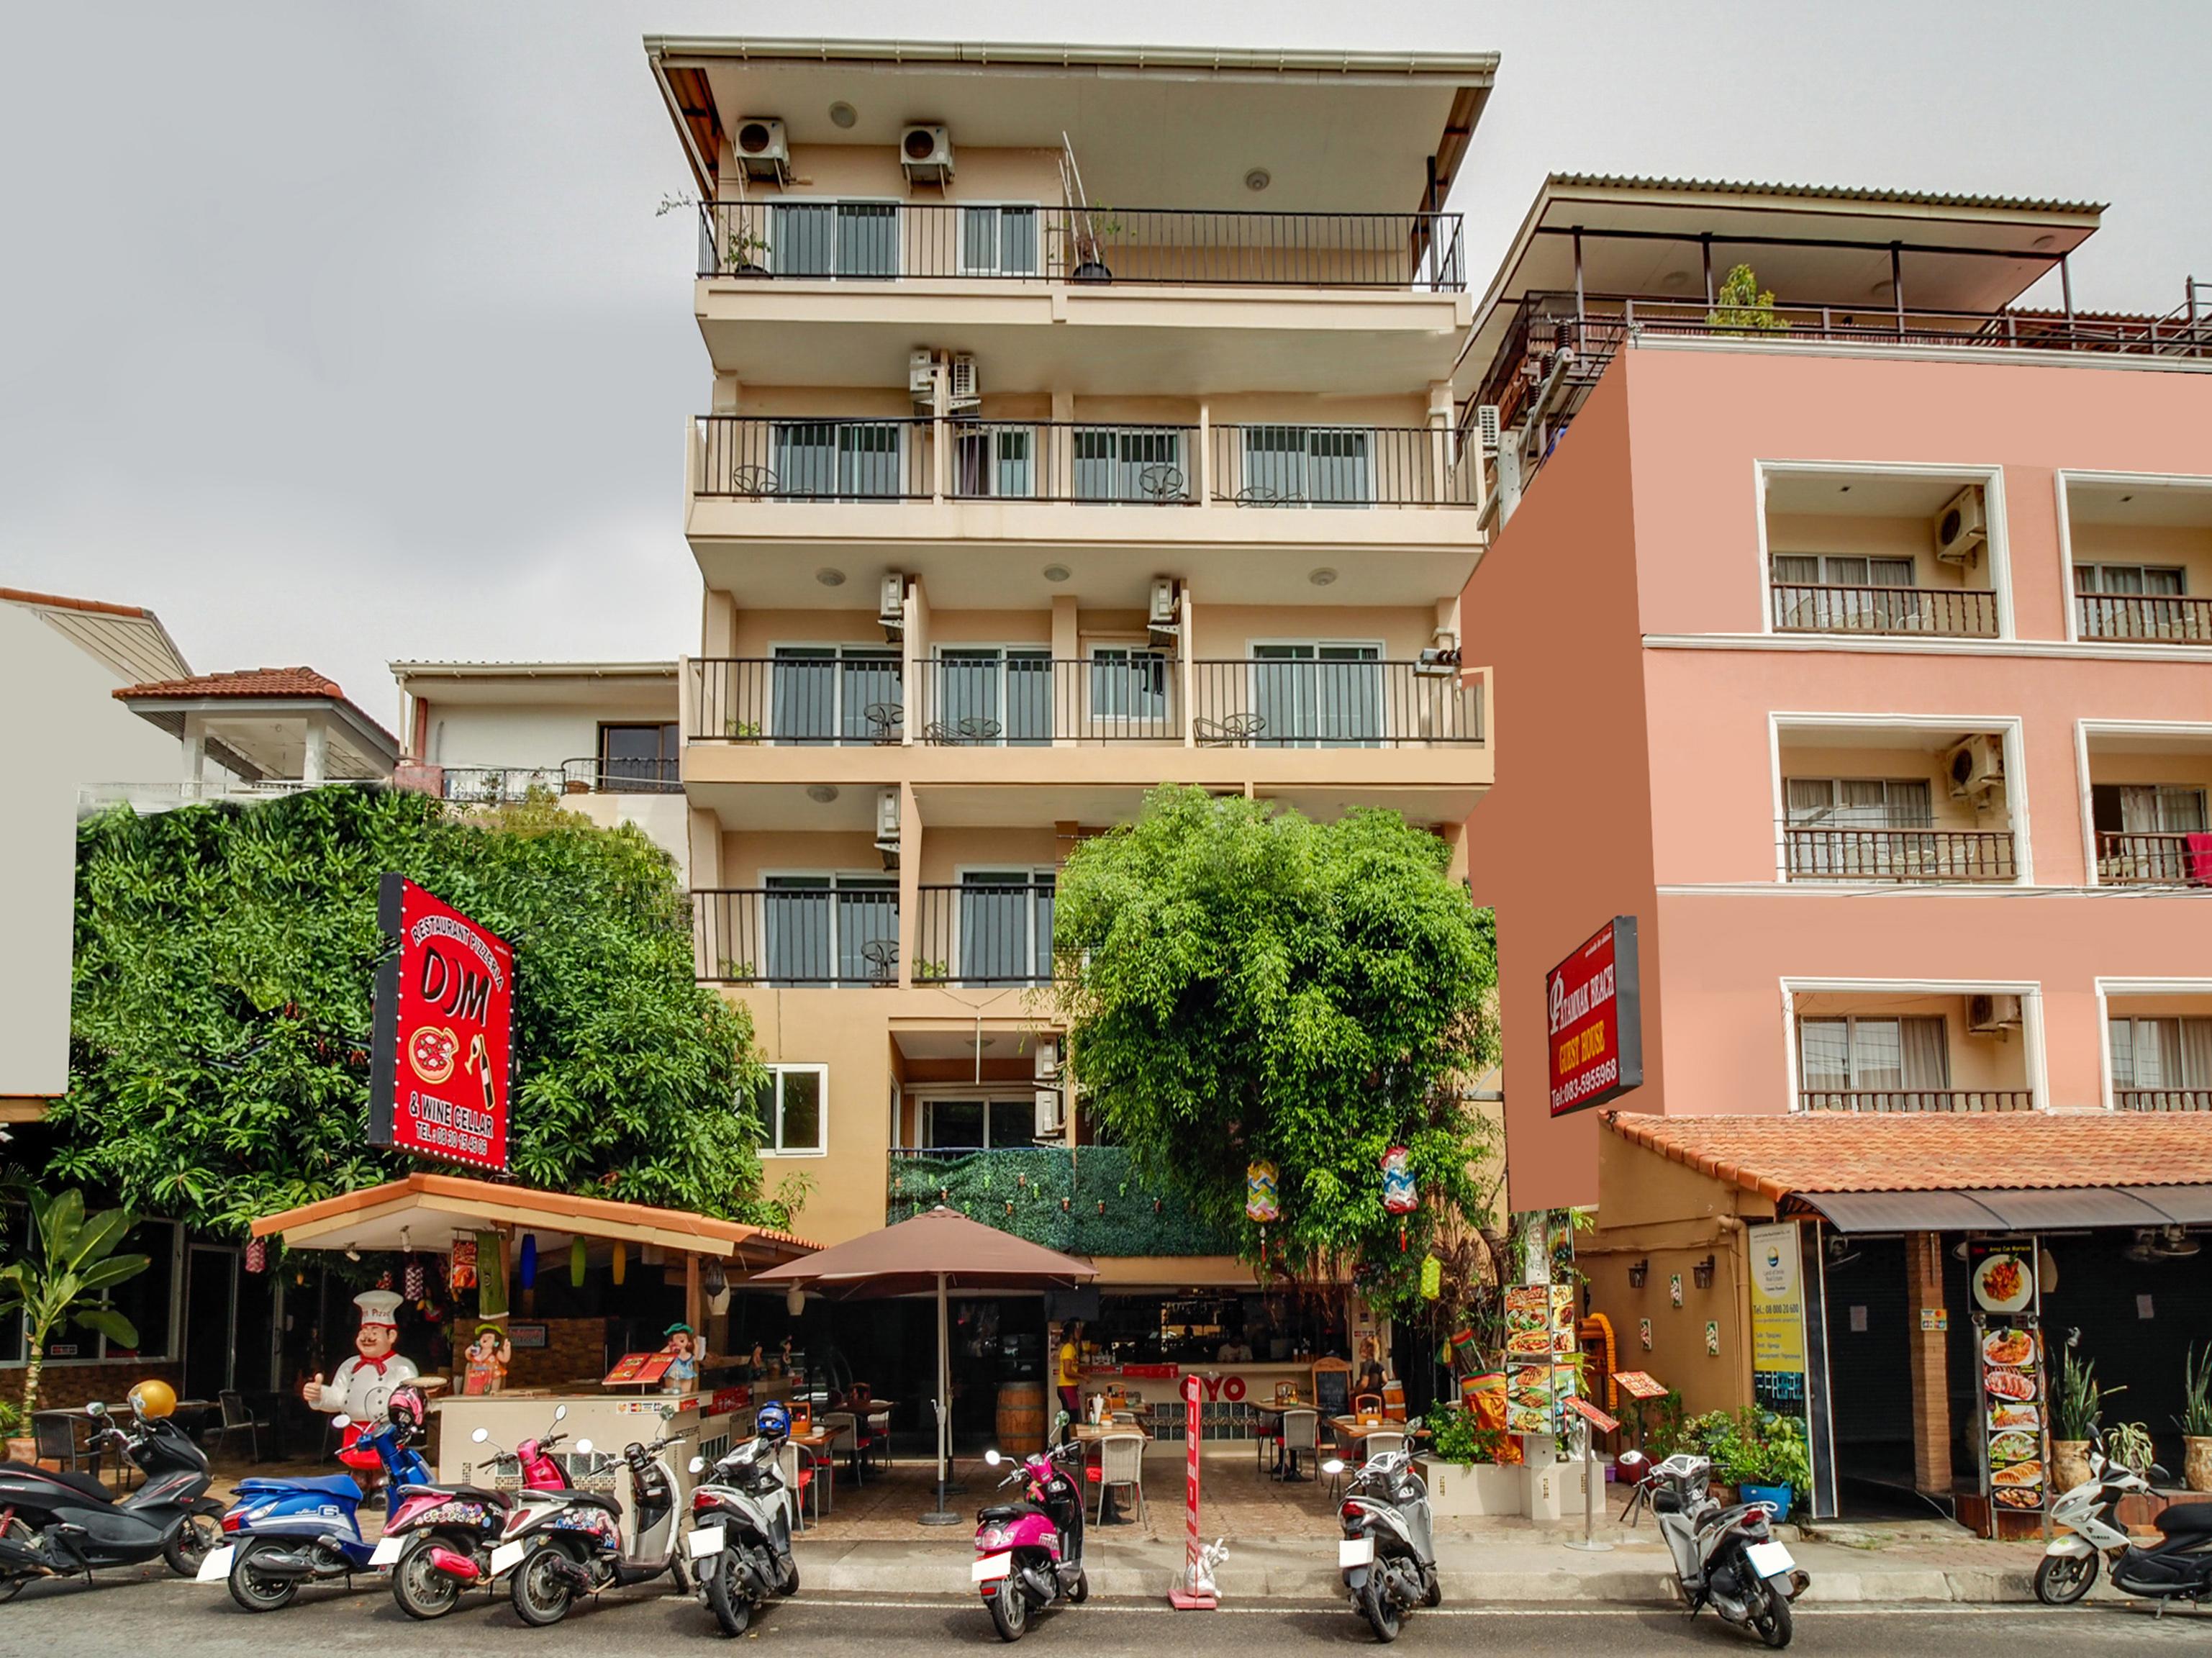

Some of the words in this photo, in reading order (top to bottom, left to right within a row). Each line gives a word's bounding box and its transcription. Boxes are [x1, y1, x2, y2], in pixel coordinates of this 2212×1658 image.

[411, 915, 470, 948] RESTAURANT
[469, 931, 504, 993] PIZZERIA
[1590, 963, 1615, 1009] BEACH
[1559, 1035, 1579, 1075] GUEST
[1581, 1019, 1605, 1063] HOUSE
[409, 1091, 420, 1118] &
[422, 1094, 452, 1127] WINE
[453, 1105, 494, 1139] CELLAR
